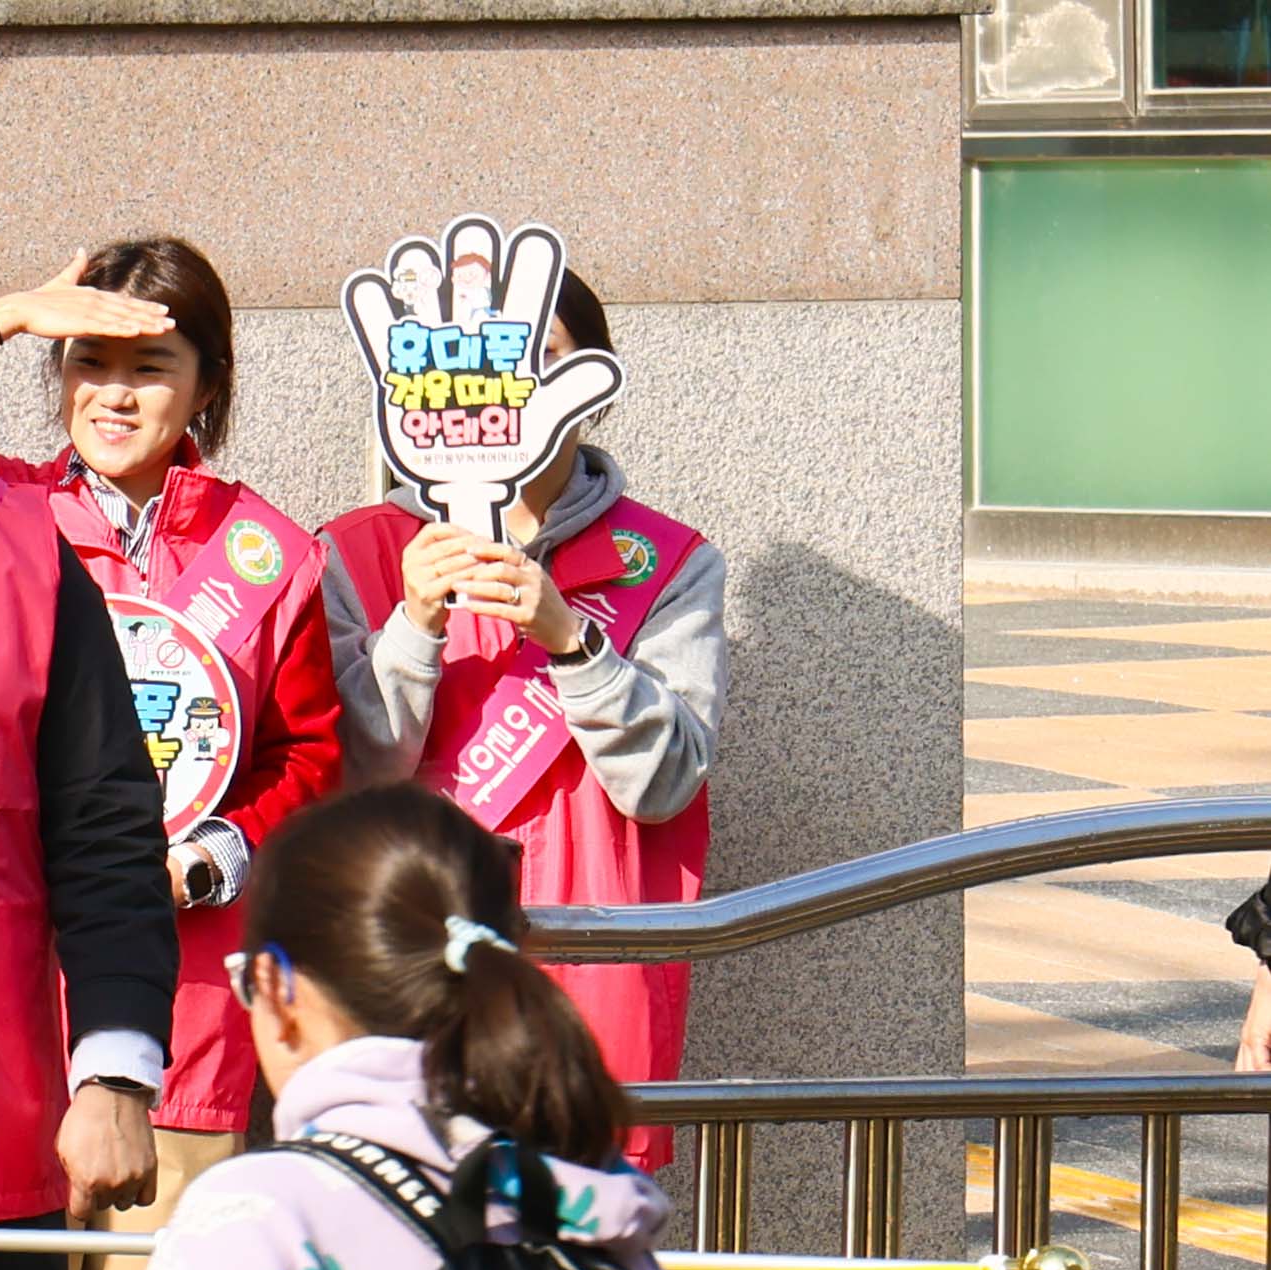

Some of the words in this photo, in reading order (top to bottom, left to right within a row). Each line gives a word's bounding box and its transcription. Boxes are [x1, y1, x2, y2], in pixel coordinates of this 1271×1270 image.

[389, 320, 531, 373] 휴대폰
[386, 370, 452, 411] 걸을
[453, 371, 536, 408] 때는
[402, 405, 521, 448] 안돼요!
